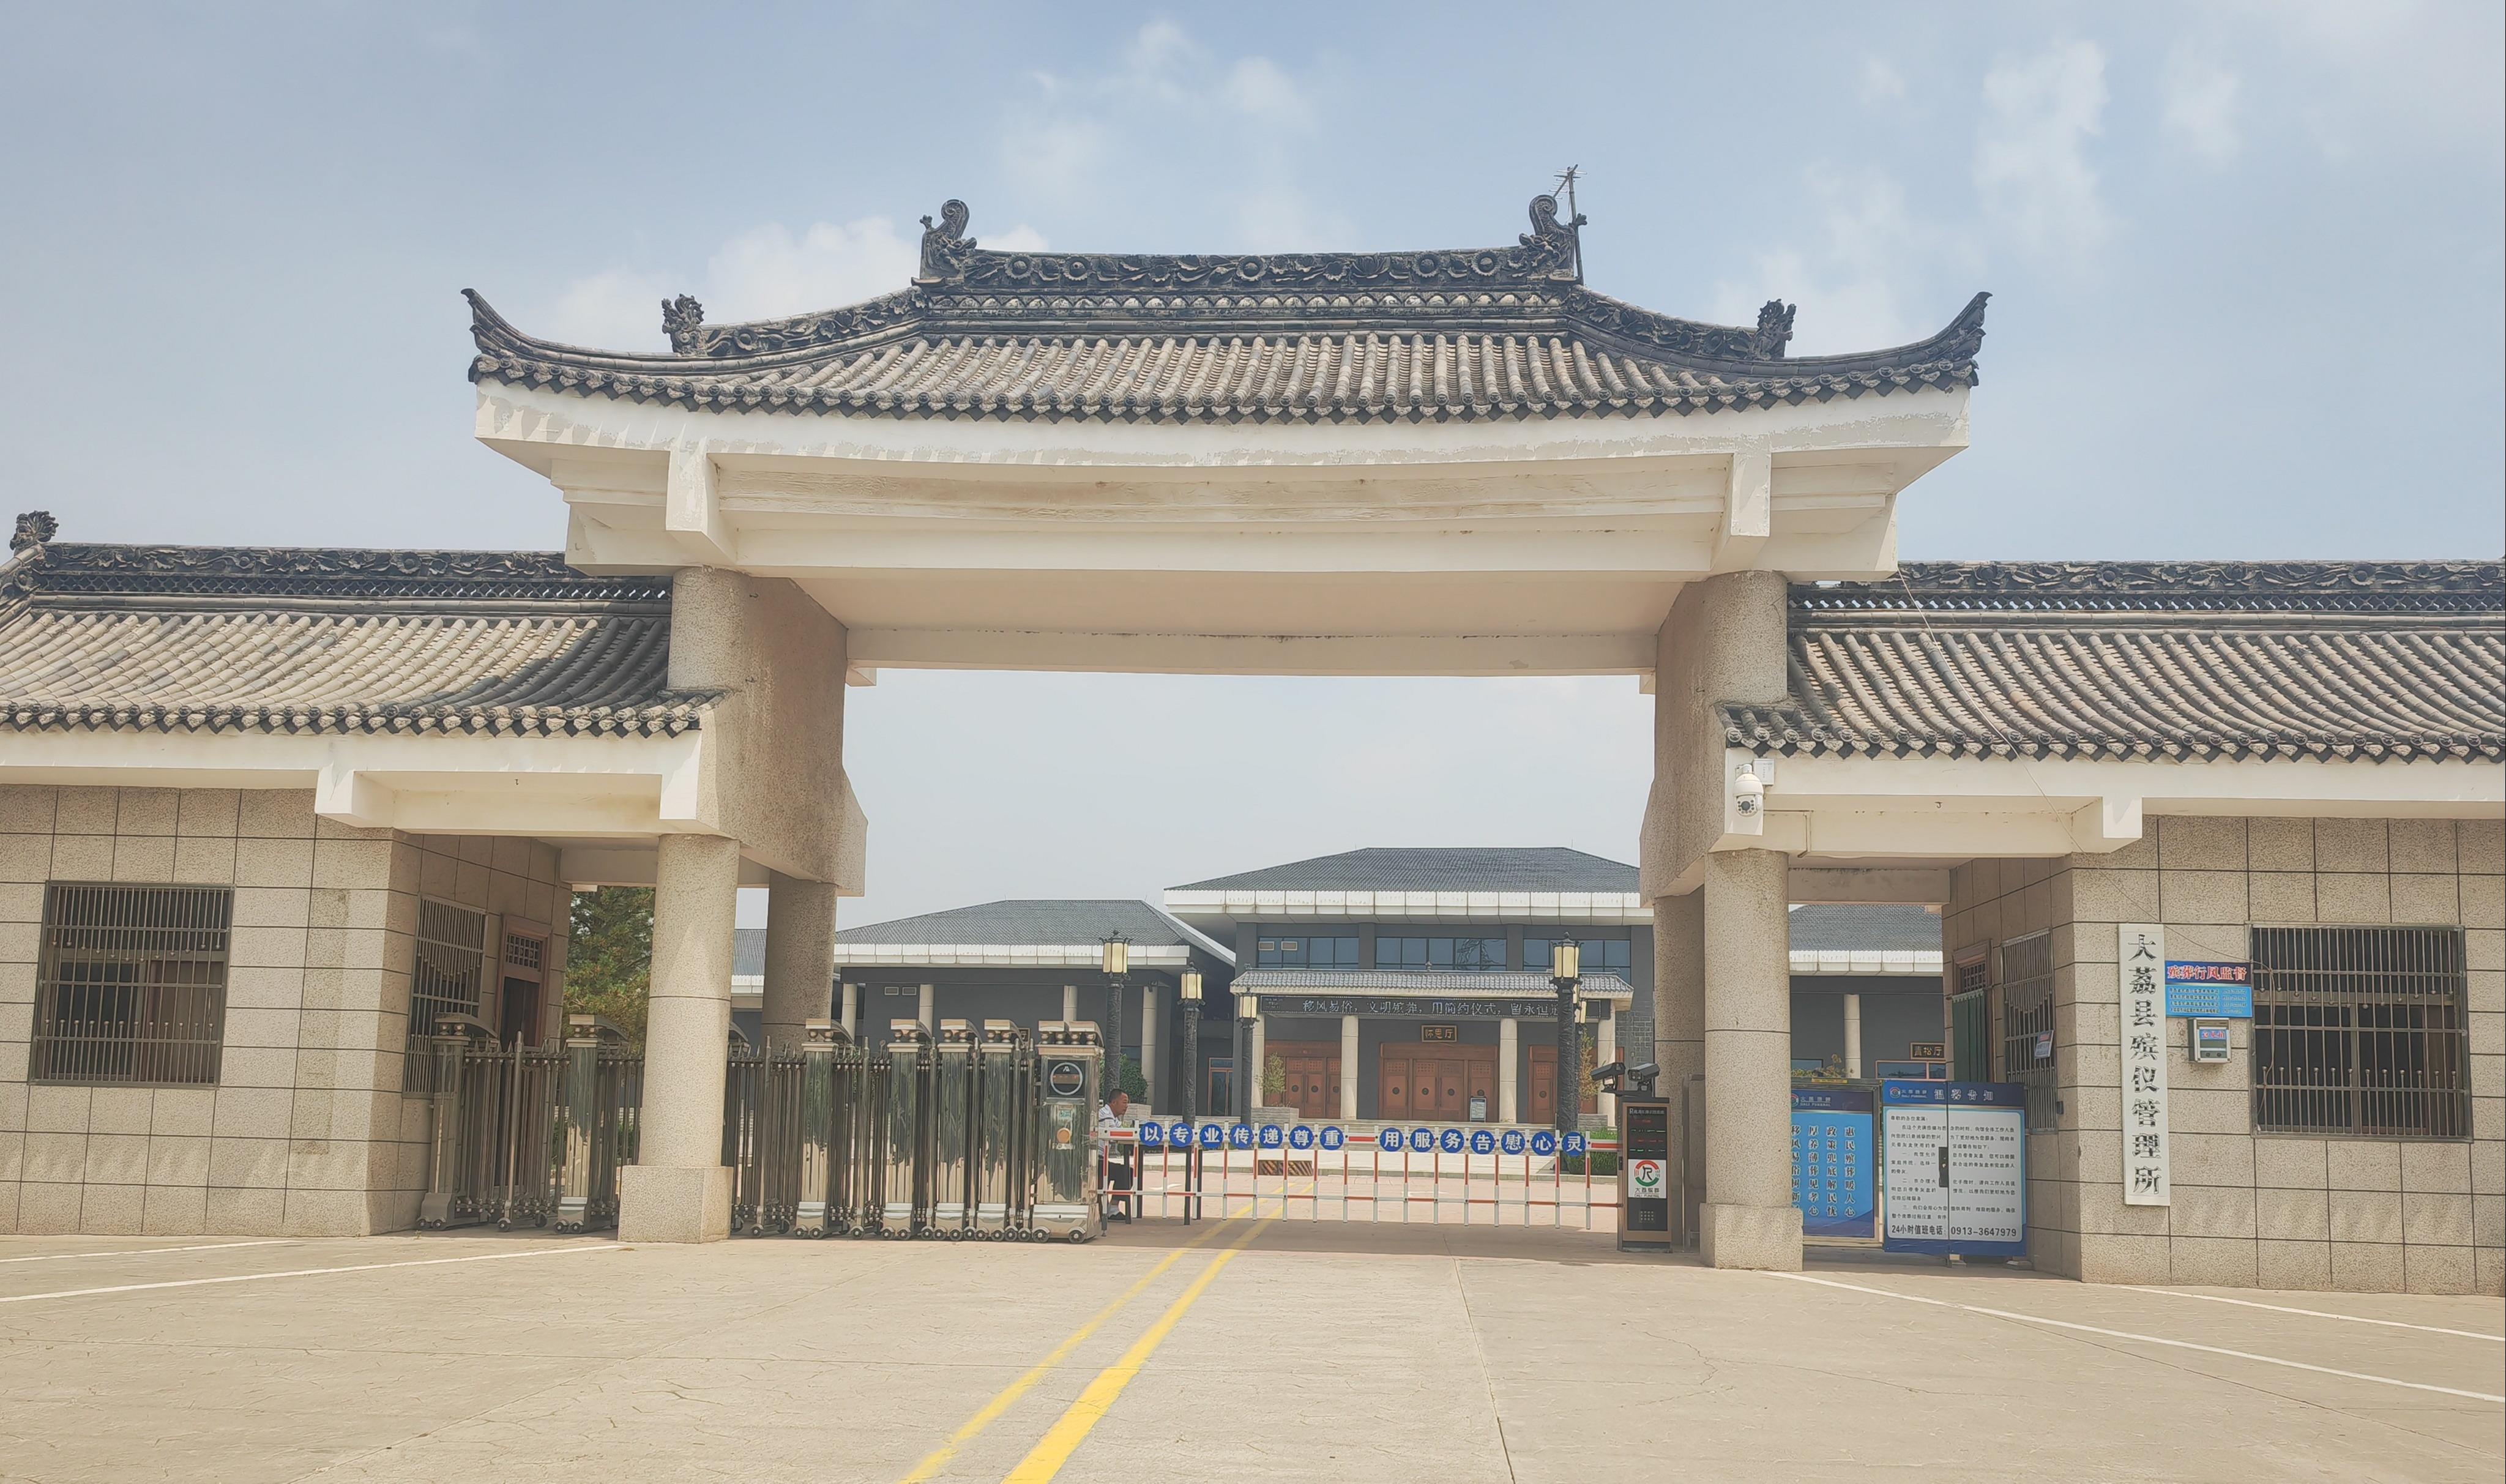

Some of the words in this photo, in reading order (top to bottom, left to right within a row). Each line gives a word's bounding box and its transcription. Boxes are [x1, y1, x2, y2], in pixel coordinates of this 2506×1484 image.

[2167, 965, 2247, 981] 殡葬行风监督
[1914, 1045, 1943, 1056] 青松厅
[2127, 934, 2162, 1195] 大荔县殡仪管理所
[1934, 1089, 1994, 1102] 温馨告知
[1144, 1126, 1340, 1146] 以专业传递尊重
[1384, 1132, 1583, 1152] 用服务告慰心灵
[1791, 1125, 1800, 1209] 移风易俗树新
[1808, 1125, 1819, 1217] 厚养薄葬见孝心
[1827, 1127, 1837, 1217] 政策兜底解民忧
[1845, 1126, 1855, 1217] 惠民殡葬暖人心
[1892, 1225, 1947, 1236] 24小时值班电话：
[1951, 1226, 2016, 1237] 0913-3647979
